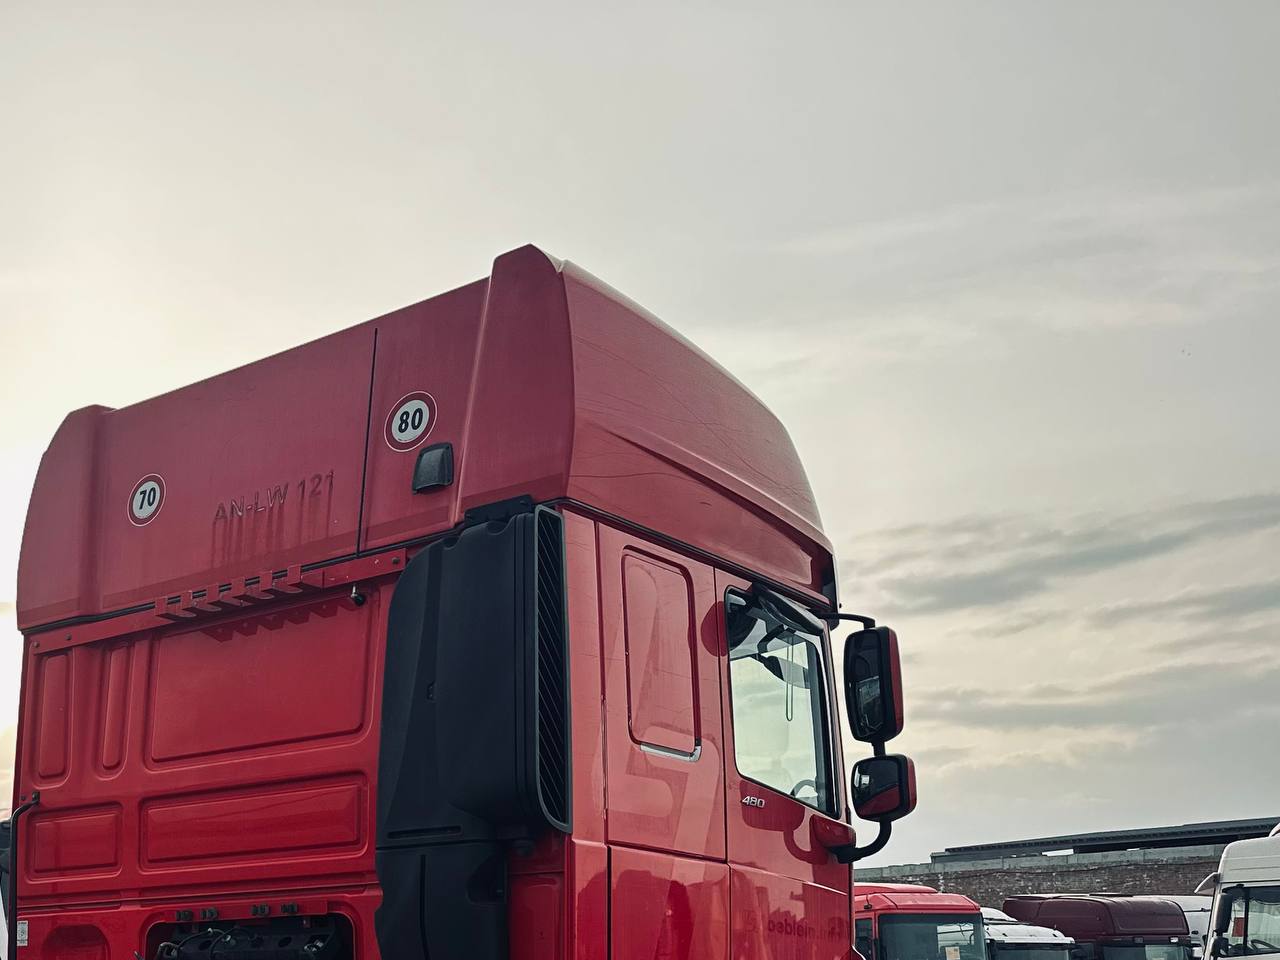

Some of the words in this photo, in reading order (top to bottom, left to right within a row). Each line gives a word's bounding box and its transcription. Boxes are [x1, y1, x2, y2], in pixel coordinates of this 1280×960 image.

[398, 407, 423, 434] 80
[139, 486, 157, 510] 70
[212, 482, 289, 523] AN-LW
[297, 469, 335, 501] 121
[741, 795, 766, 809] 480
